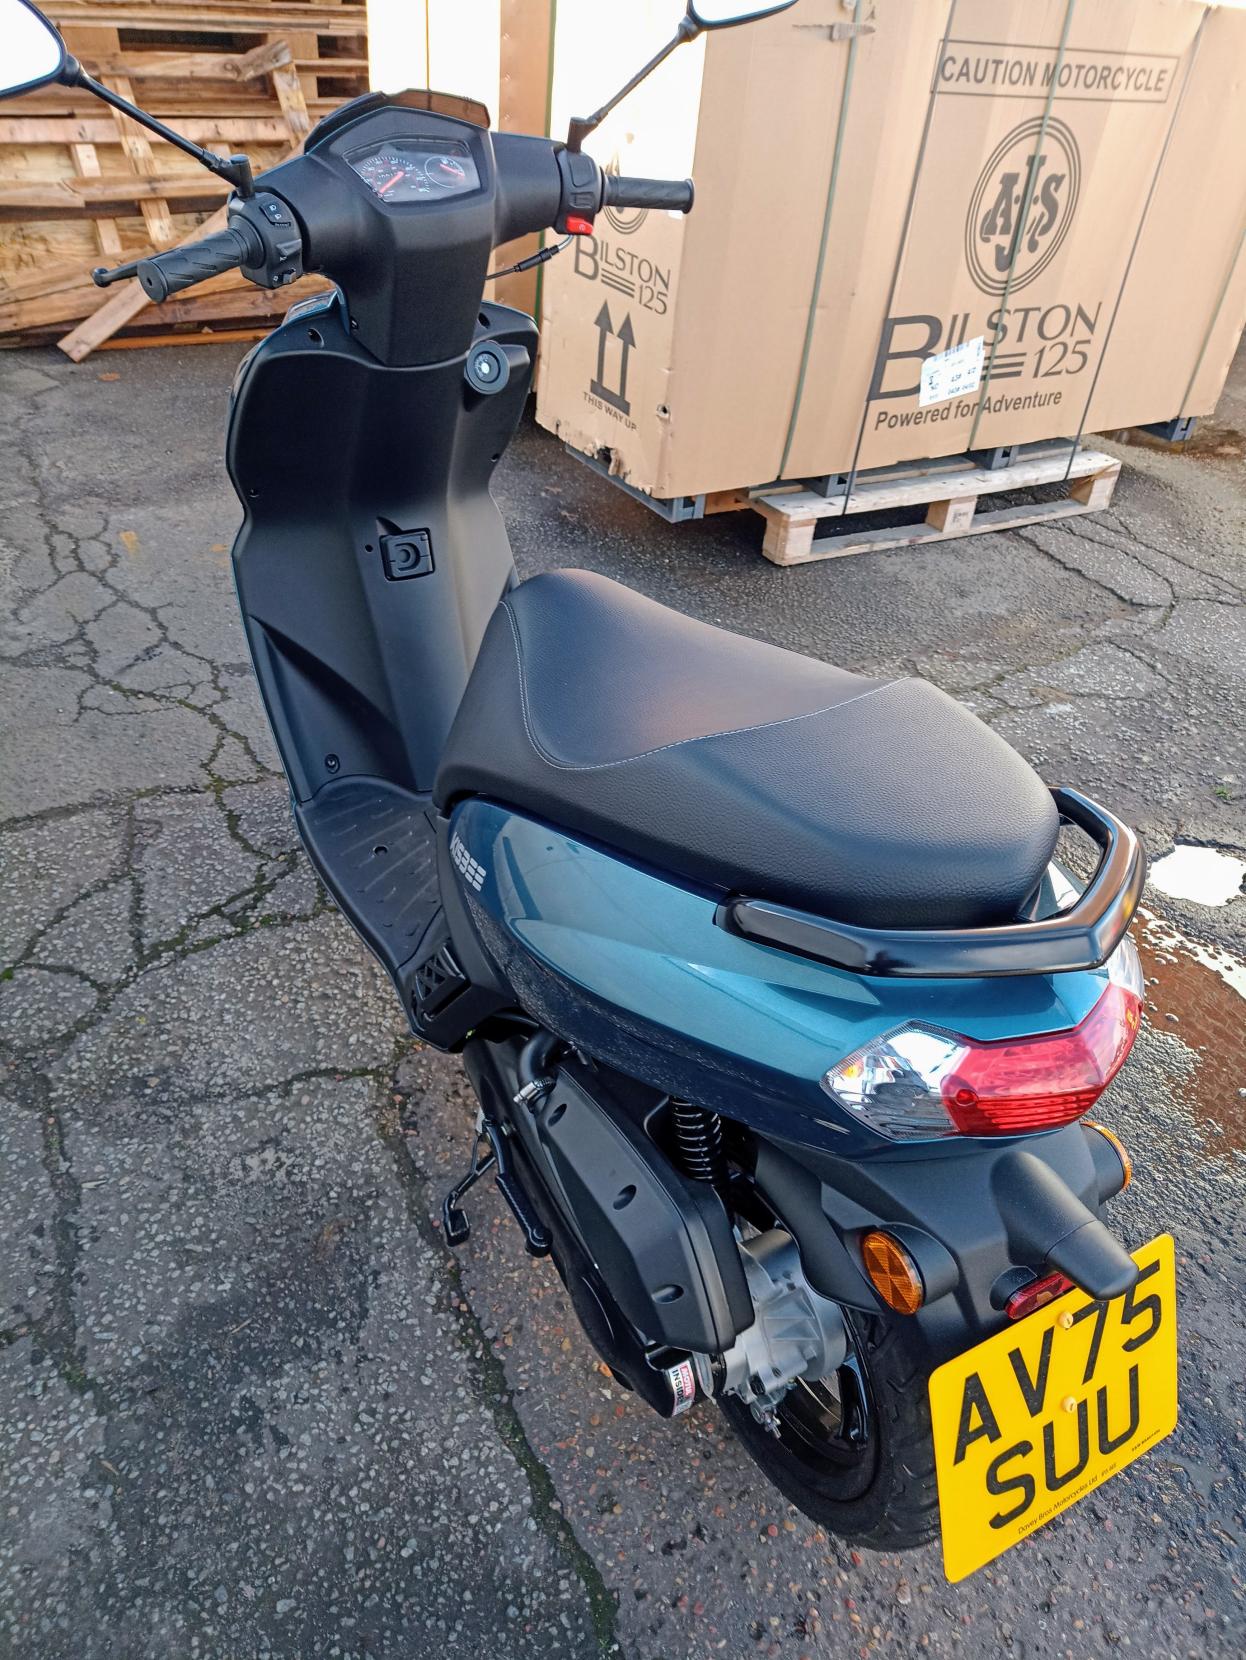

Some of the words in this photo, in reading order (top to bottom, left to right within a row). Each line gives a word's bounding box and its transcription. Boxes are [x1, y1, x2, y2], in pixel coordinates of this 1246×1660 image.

[940, 56, 1038, 86] CAUTION
[1041, 62, 1168, 92] MOTORCYCLE
[573, 233, 671, 292] BILSTON
[638, 284, 668, 315] 125
[867, 301, 1103, 401] BILSTON
[1032, 339, 1091, 379] 125
[583, 391, 603, 410] THIS
[604, 404, 624, 423] WAY
[874, 401, 951, 431] Powered
[953, 397, 979, 421] for
[981, 390, 1062, 414] Adventure
[953, 1258, 1160, 1466] AV75
[986, 1363, 1139, 1529] SUU
[1017, 1517, 1038, 1534] Davey
[1038, 1507, 1053, 1520] Bros
[1053, 1482, 1088, 1511] Motorcycles
